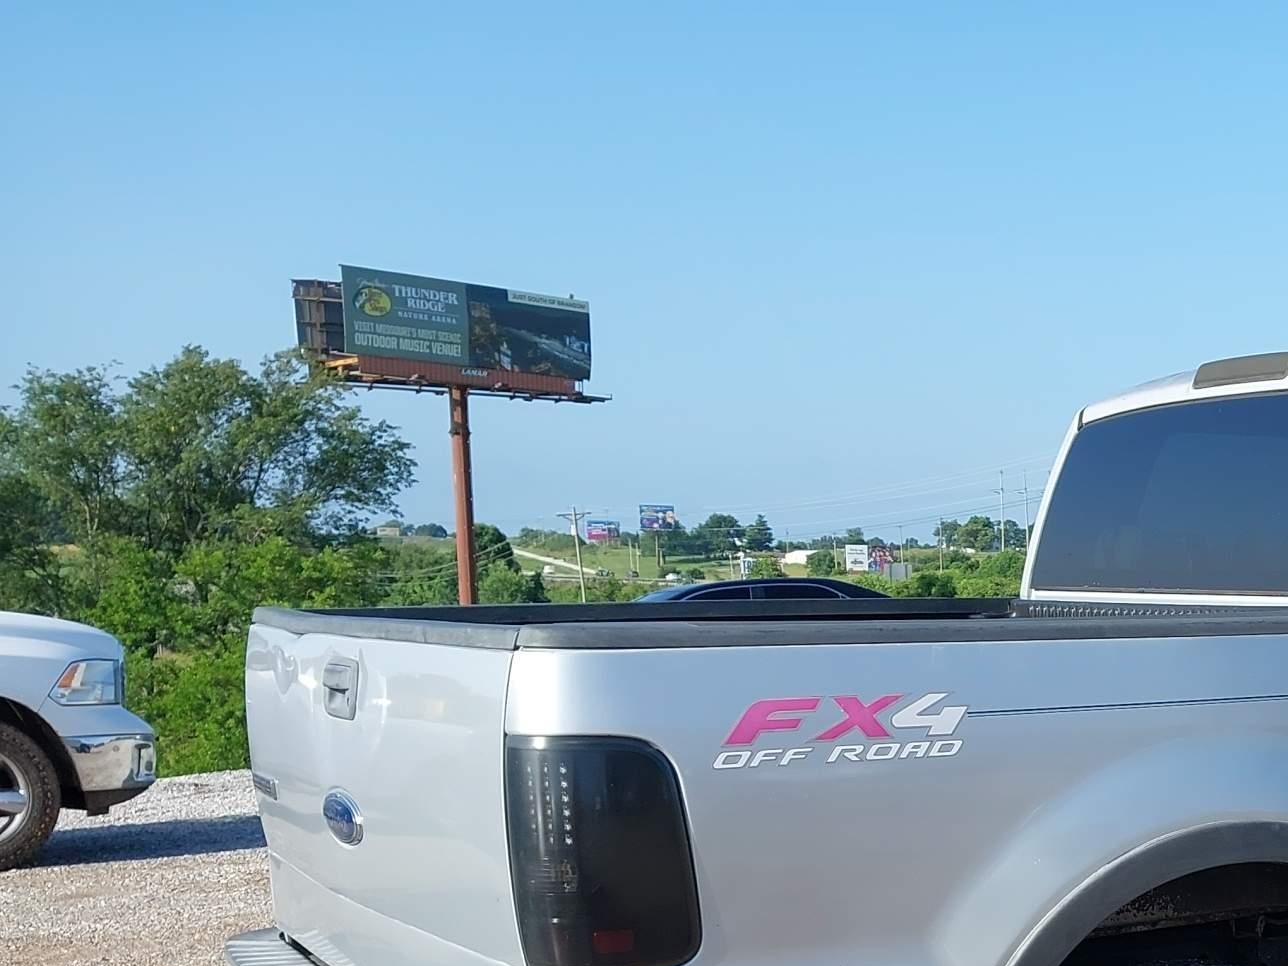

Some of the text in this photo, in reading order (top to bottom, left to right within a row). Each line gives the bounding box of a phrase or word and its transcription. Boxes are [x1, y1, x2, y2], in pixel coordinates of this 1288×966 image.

[391, 284, 460, 305] THUNDER
[407, 297, 447, 313] RIDGE
[353, 320, 374, 332] VISIT
[398, 311, 457, 324] NATURE ARENA
[354, 332, 462, 357] OUTDOOR MUSIC VENUE!
[721, 691, 969, 748] FX4
[712, 739, 964, 770] OFF ROAD
